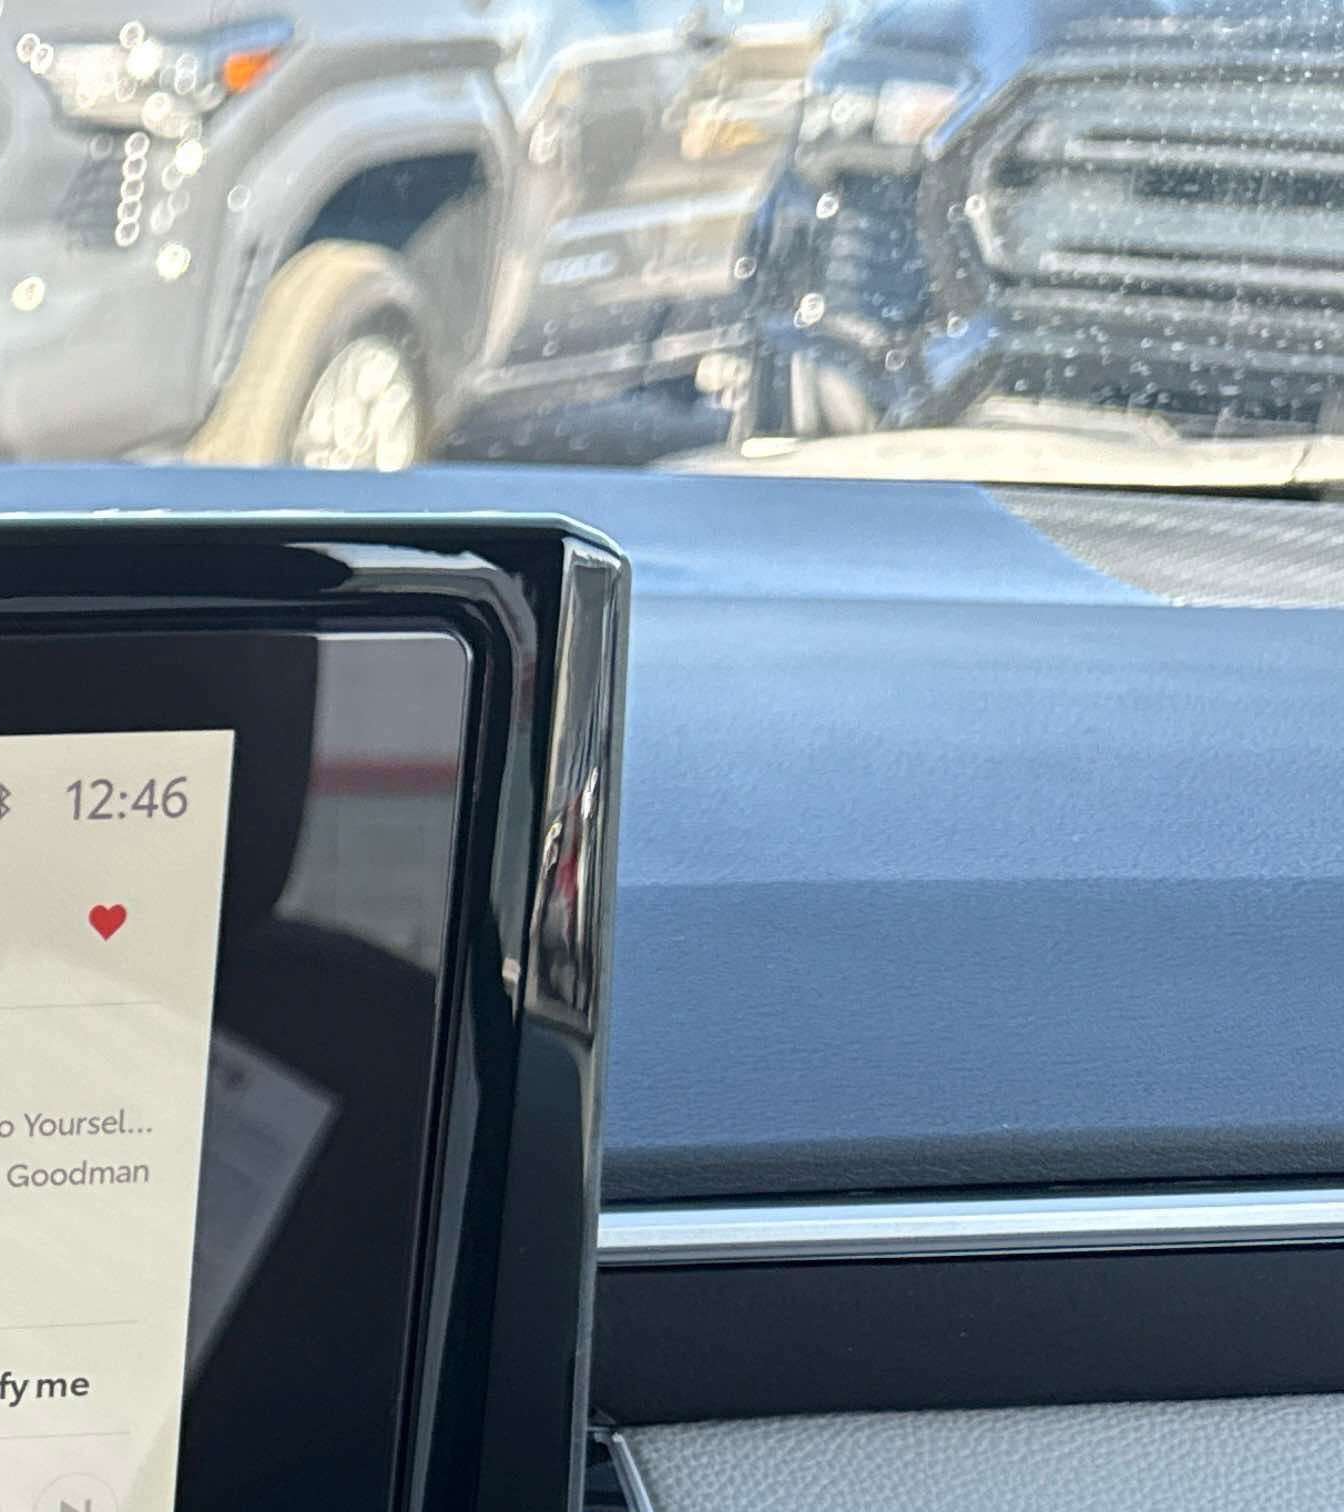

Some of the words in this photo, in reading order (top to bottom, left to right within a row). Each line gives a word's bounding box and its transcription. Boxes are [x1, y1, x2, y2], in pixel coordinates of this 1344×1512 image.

[66, 777, 189, 821] 12:46
[7, 1159, 150, 1189] Goodman
[36, 1375, 90, 1399] me
